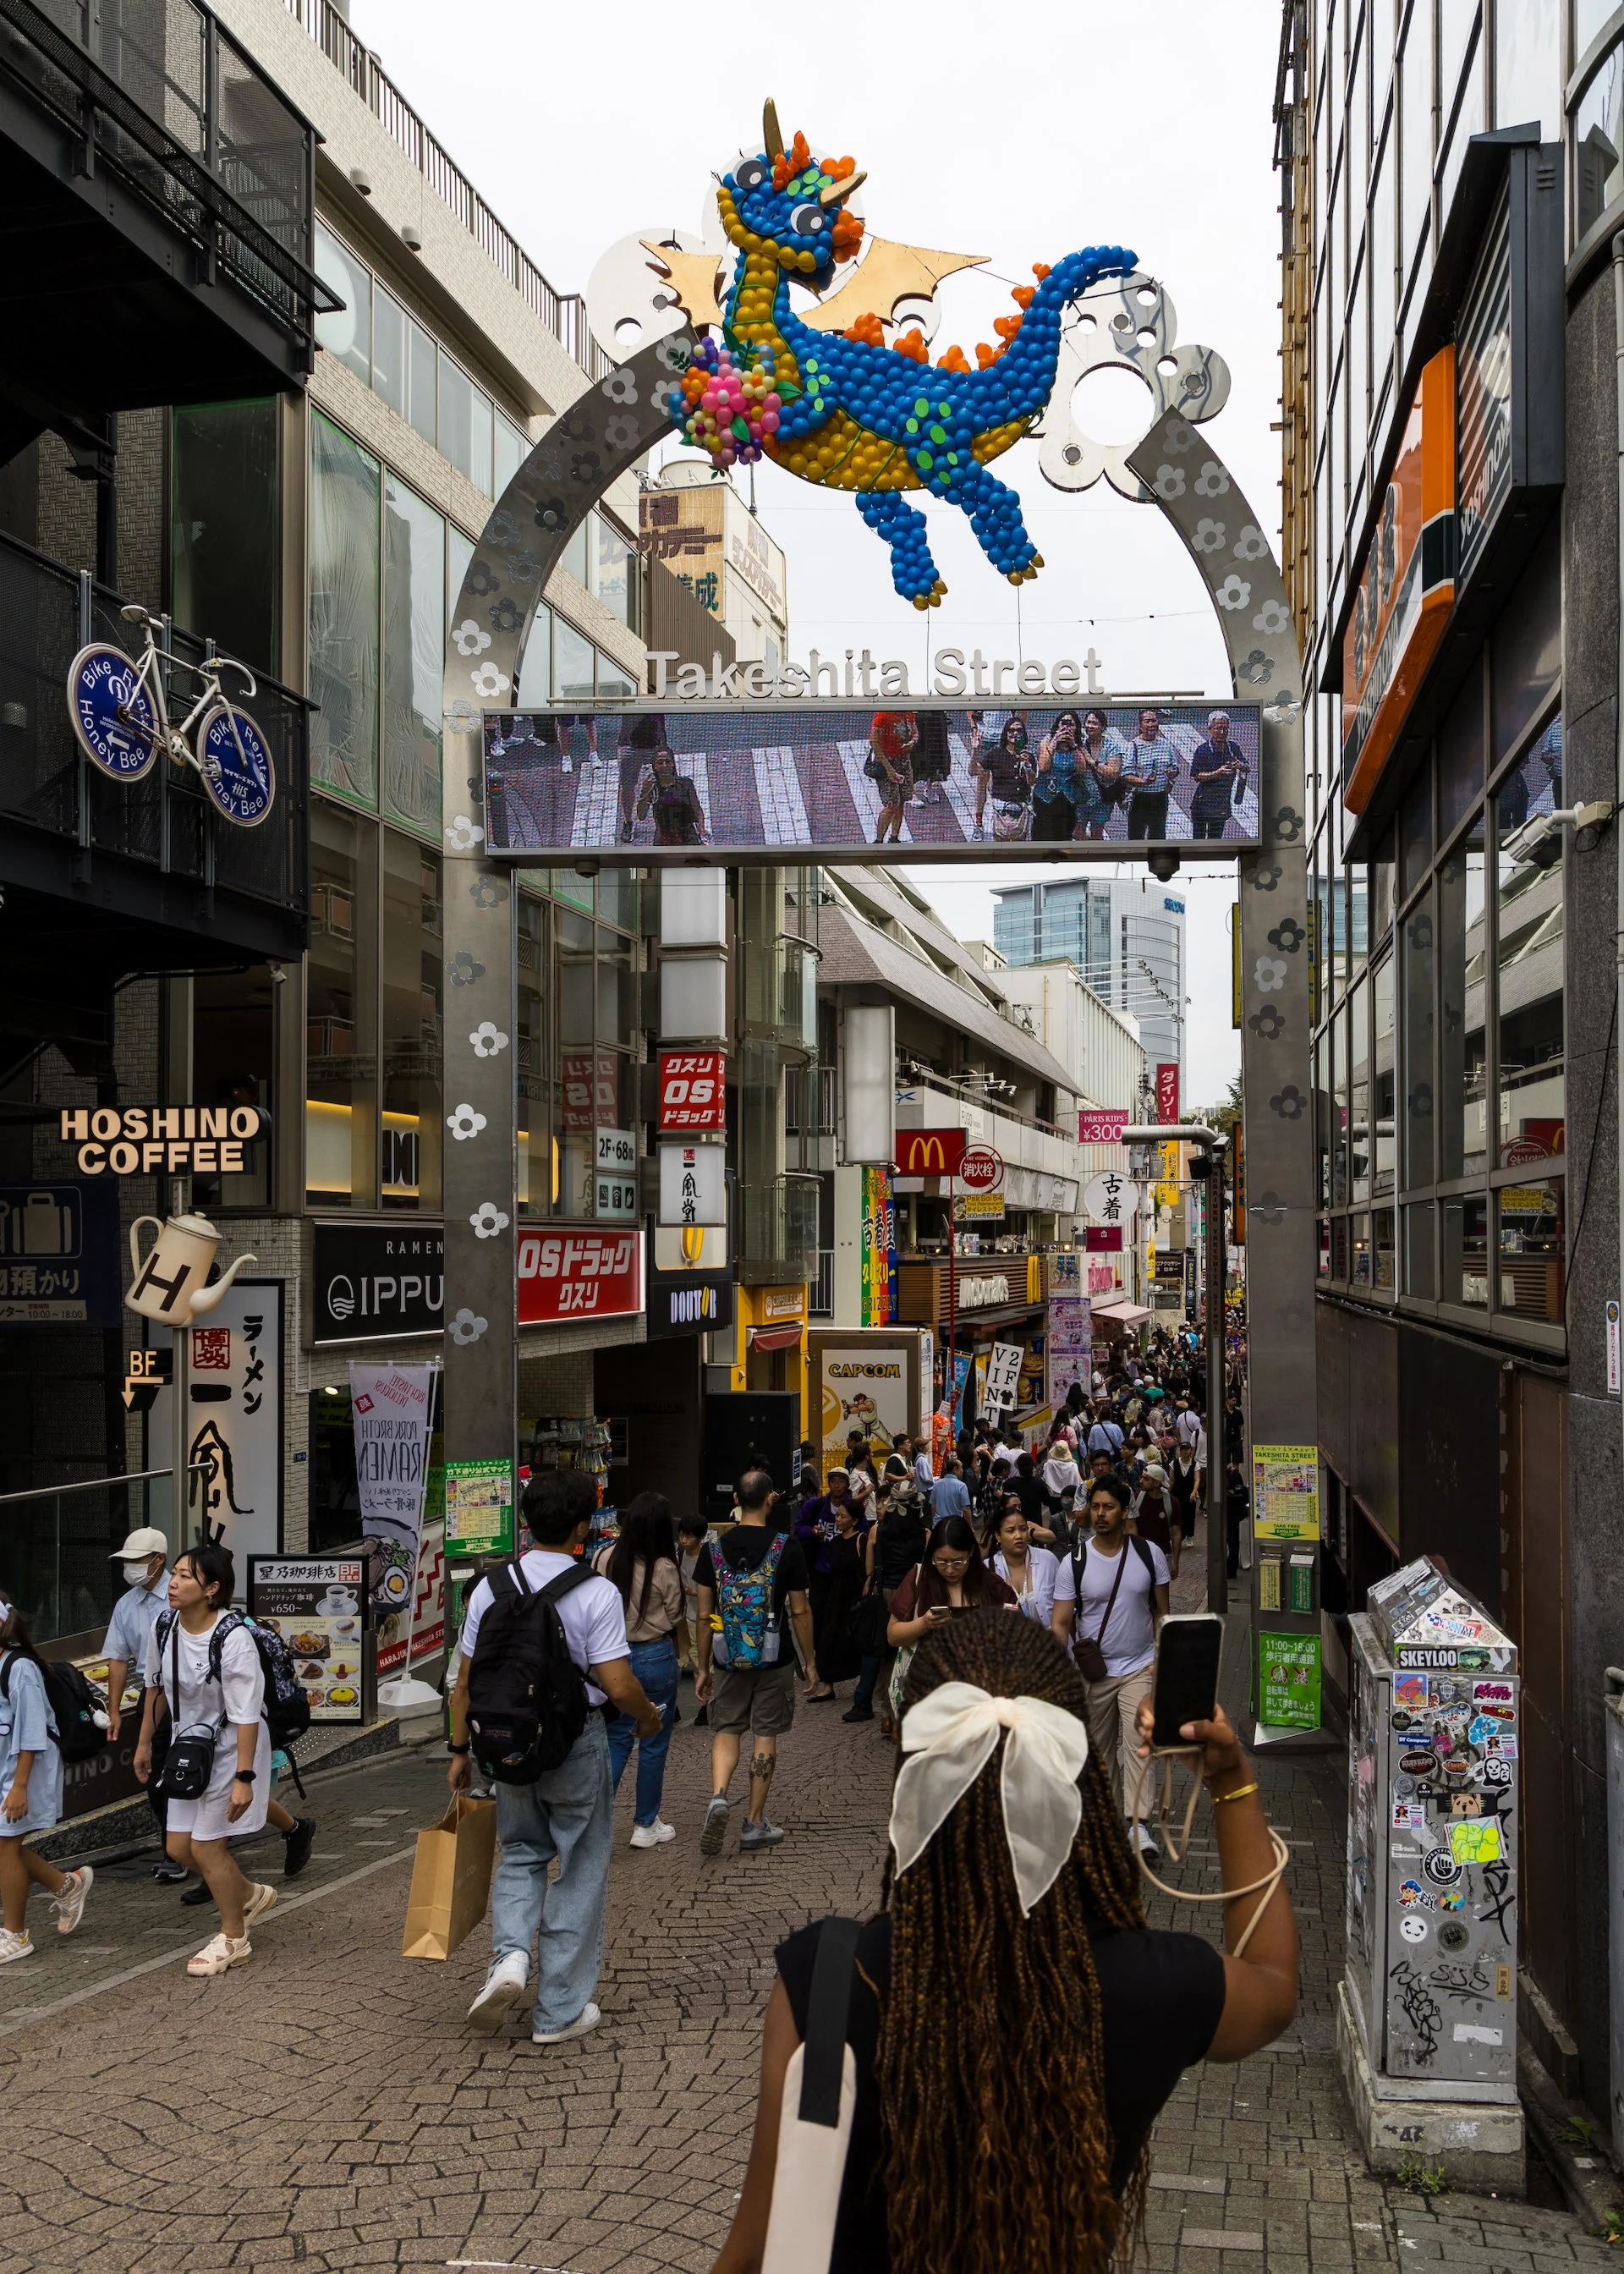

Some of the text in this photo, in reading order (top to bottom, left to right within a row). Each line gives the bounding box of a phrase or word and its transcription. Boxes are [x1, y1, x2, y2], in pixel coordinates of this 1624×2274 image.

[82, 661, 112, 689] Bike
[645, 647, 1105, 699] Takeshita Street
[80, 699, 145, 769] Honey Bee
[231, 783, 248, 798] HIS
[241, 795, 264, 816] Bee
[666, 1057, 713, 1074] クスリ
[664, 1079, 715, 1104] OS
[1162, 1071, 1174, 1115] ダイソー
[61, 1107, 259, 1140] HOSHINO
[663, 1110, 716, 1123] ドラッグ
[1084, 1124, 1122, 1140] ¥300
[78, 1142, 244, 1174] COFFEE
[963, 1162, 994, 1178] 消火栓
[1102, 1173, 1123, 1220] 古着
[862, 1206, 895, 1253] 古着屋
[387, 1241, 444, 1255] RAMEN
[518, 1239, 635, 1279] OSドラッグ
[558, 1283, 599, 1310] クスリ
[671, 1286, 716, 1323] DOUTOR
[863, 1295, 897, 1312] GRIZZLY
[129, 1351, 157, 1376] BF
[243, 1316, 264, 1414] ラーメン
[829, 1364, 900, 1379] CAPCOM
[189, 1383, 254, 1548] 一風
[259, 1565, 337, 1581] 星乃珈琲店
[340, 1565, 359, 1574] BF
[1265, 1653, 1315, 1665] 歩行者用道路
[1401, 1651, 1457, 1667] SKEYLOO
[1266, 1697, 1315, 1711] 押して歩きましょう
